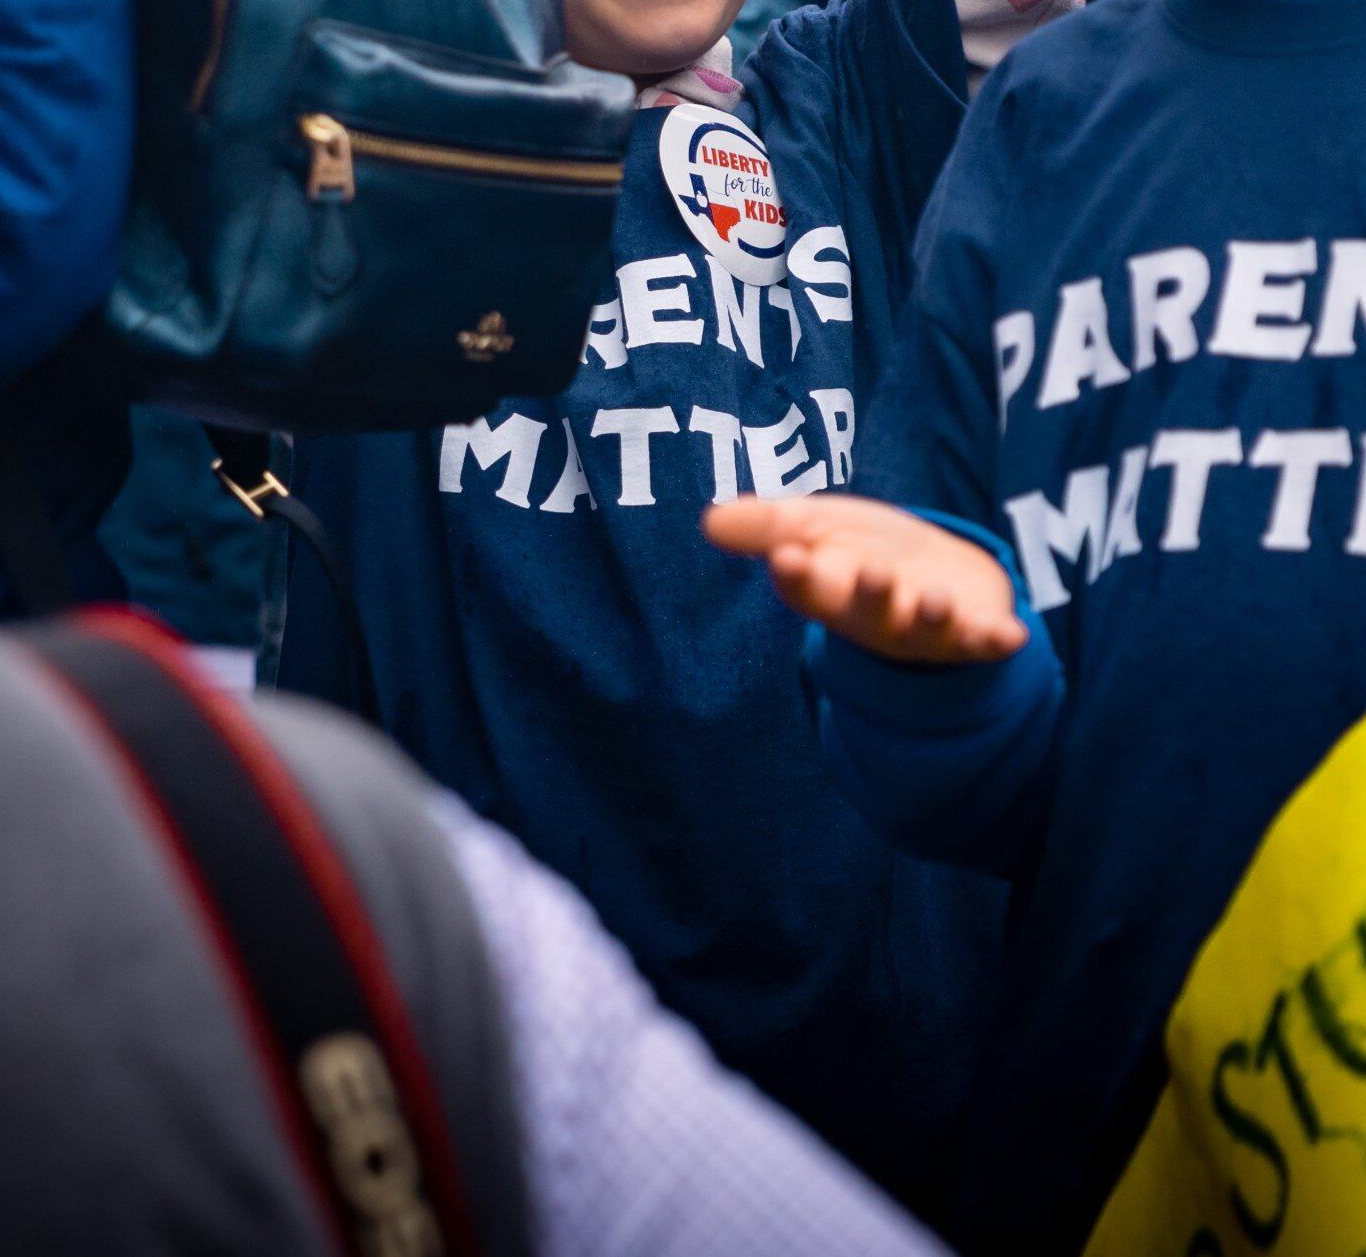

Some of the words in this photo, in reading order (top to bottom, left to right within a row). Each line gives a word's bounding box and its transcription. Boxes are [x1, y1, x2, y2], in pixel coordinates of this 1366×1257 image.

[701, 145, 769, 178] LIBERTY
[723, 173, 748, 198] for
[750, 177, 773, 198] the
[743, 198, 788, 228] KIDS
[438, 387, 855, 514] MATTER
